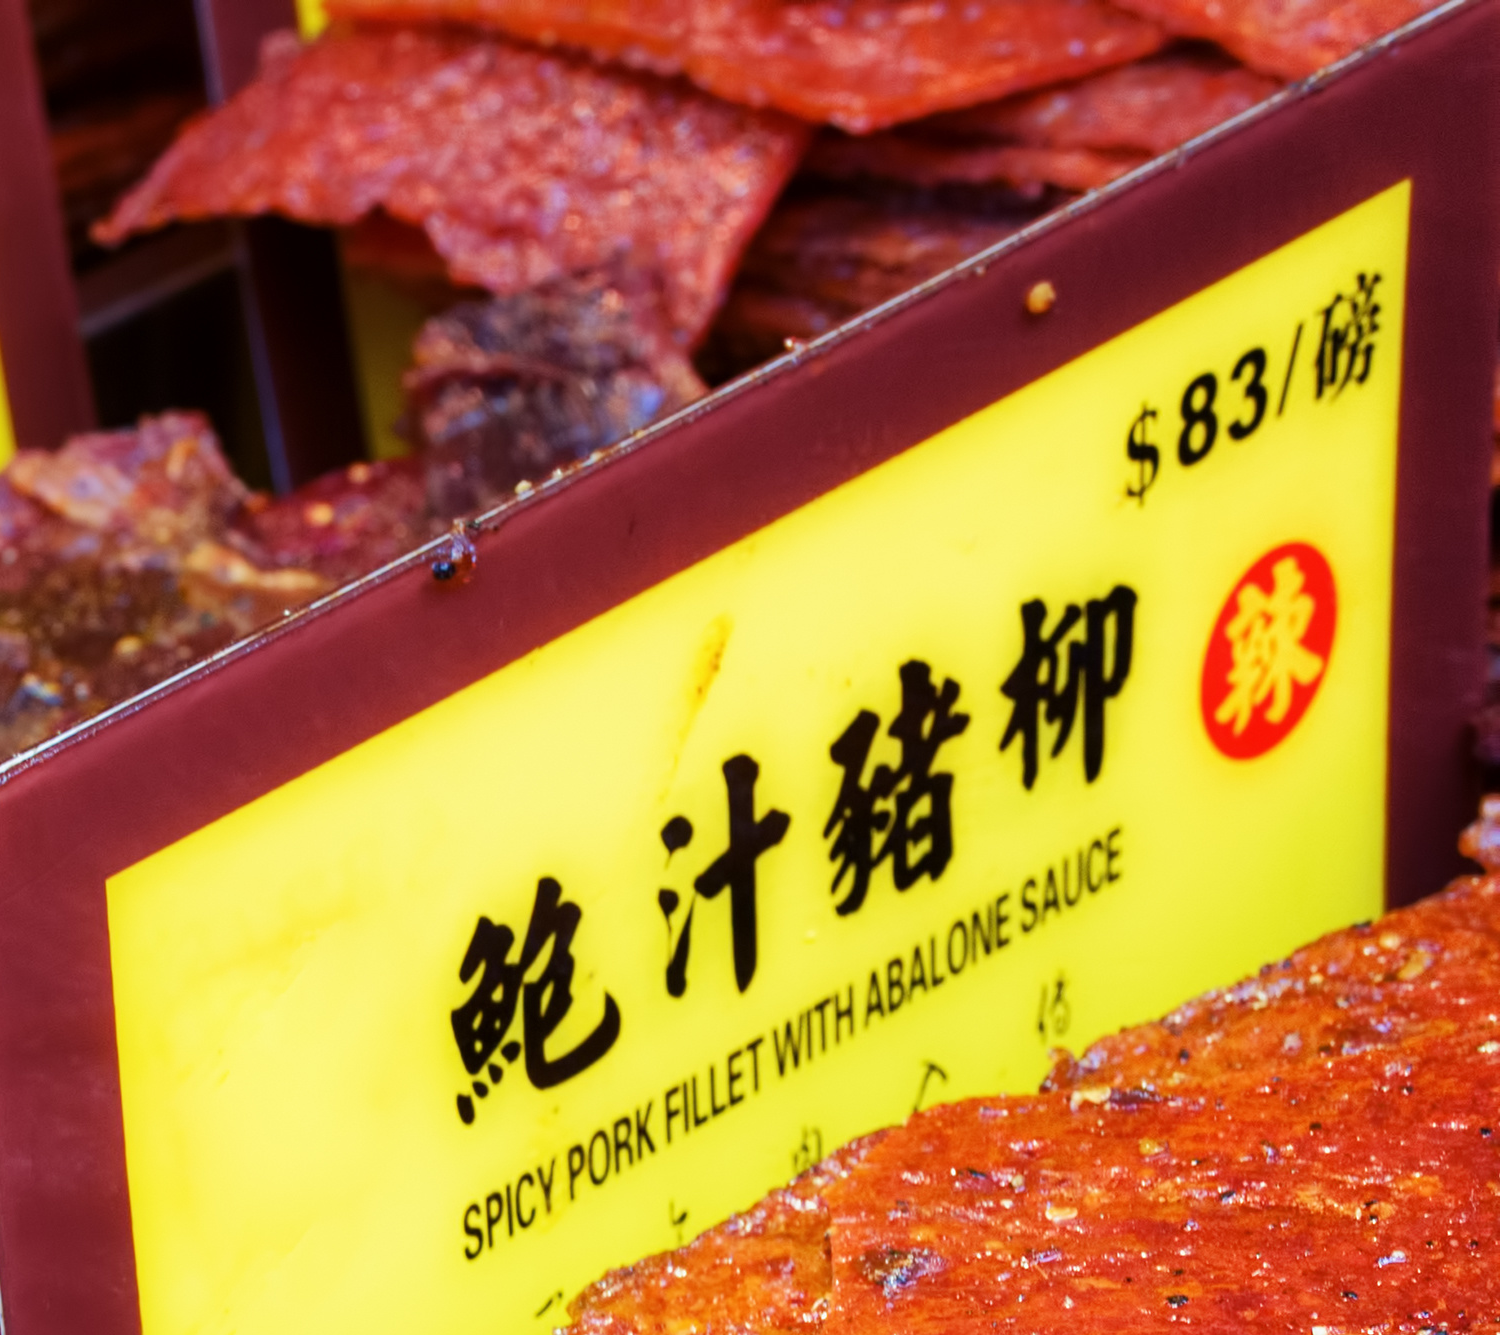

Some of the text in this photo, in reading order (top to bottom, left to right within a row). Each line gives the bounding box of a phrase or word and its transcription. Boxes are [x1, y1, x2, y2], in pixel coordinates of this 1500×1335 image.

[1122, 270, 1384, 506] $83/磅
[1212, 554, 1324, 739] 辣
[450, 585, 1138, 1125] 鮑汁豬柳
[460, 1148, 560, 1264] SPICY
[566, 1100, 658, 1202] PORK
[663, 1033, 766, 1150] FILLET
[770, 983, 858, 1080] WITH
[863, 890, 1012, 1032] ABALONE
[1019, 825, 1126, 936] SAUCE
